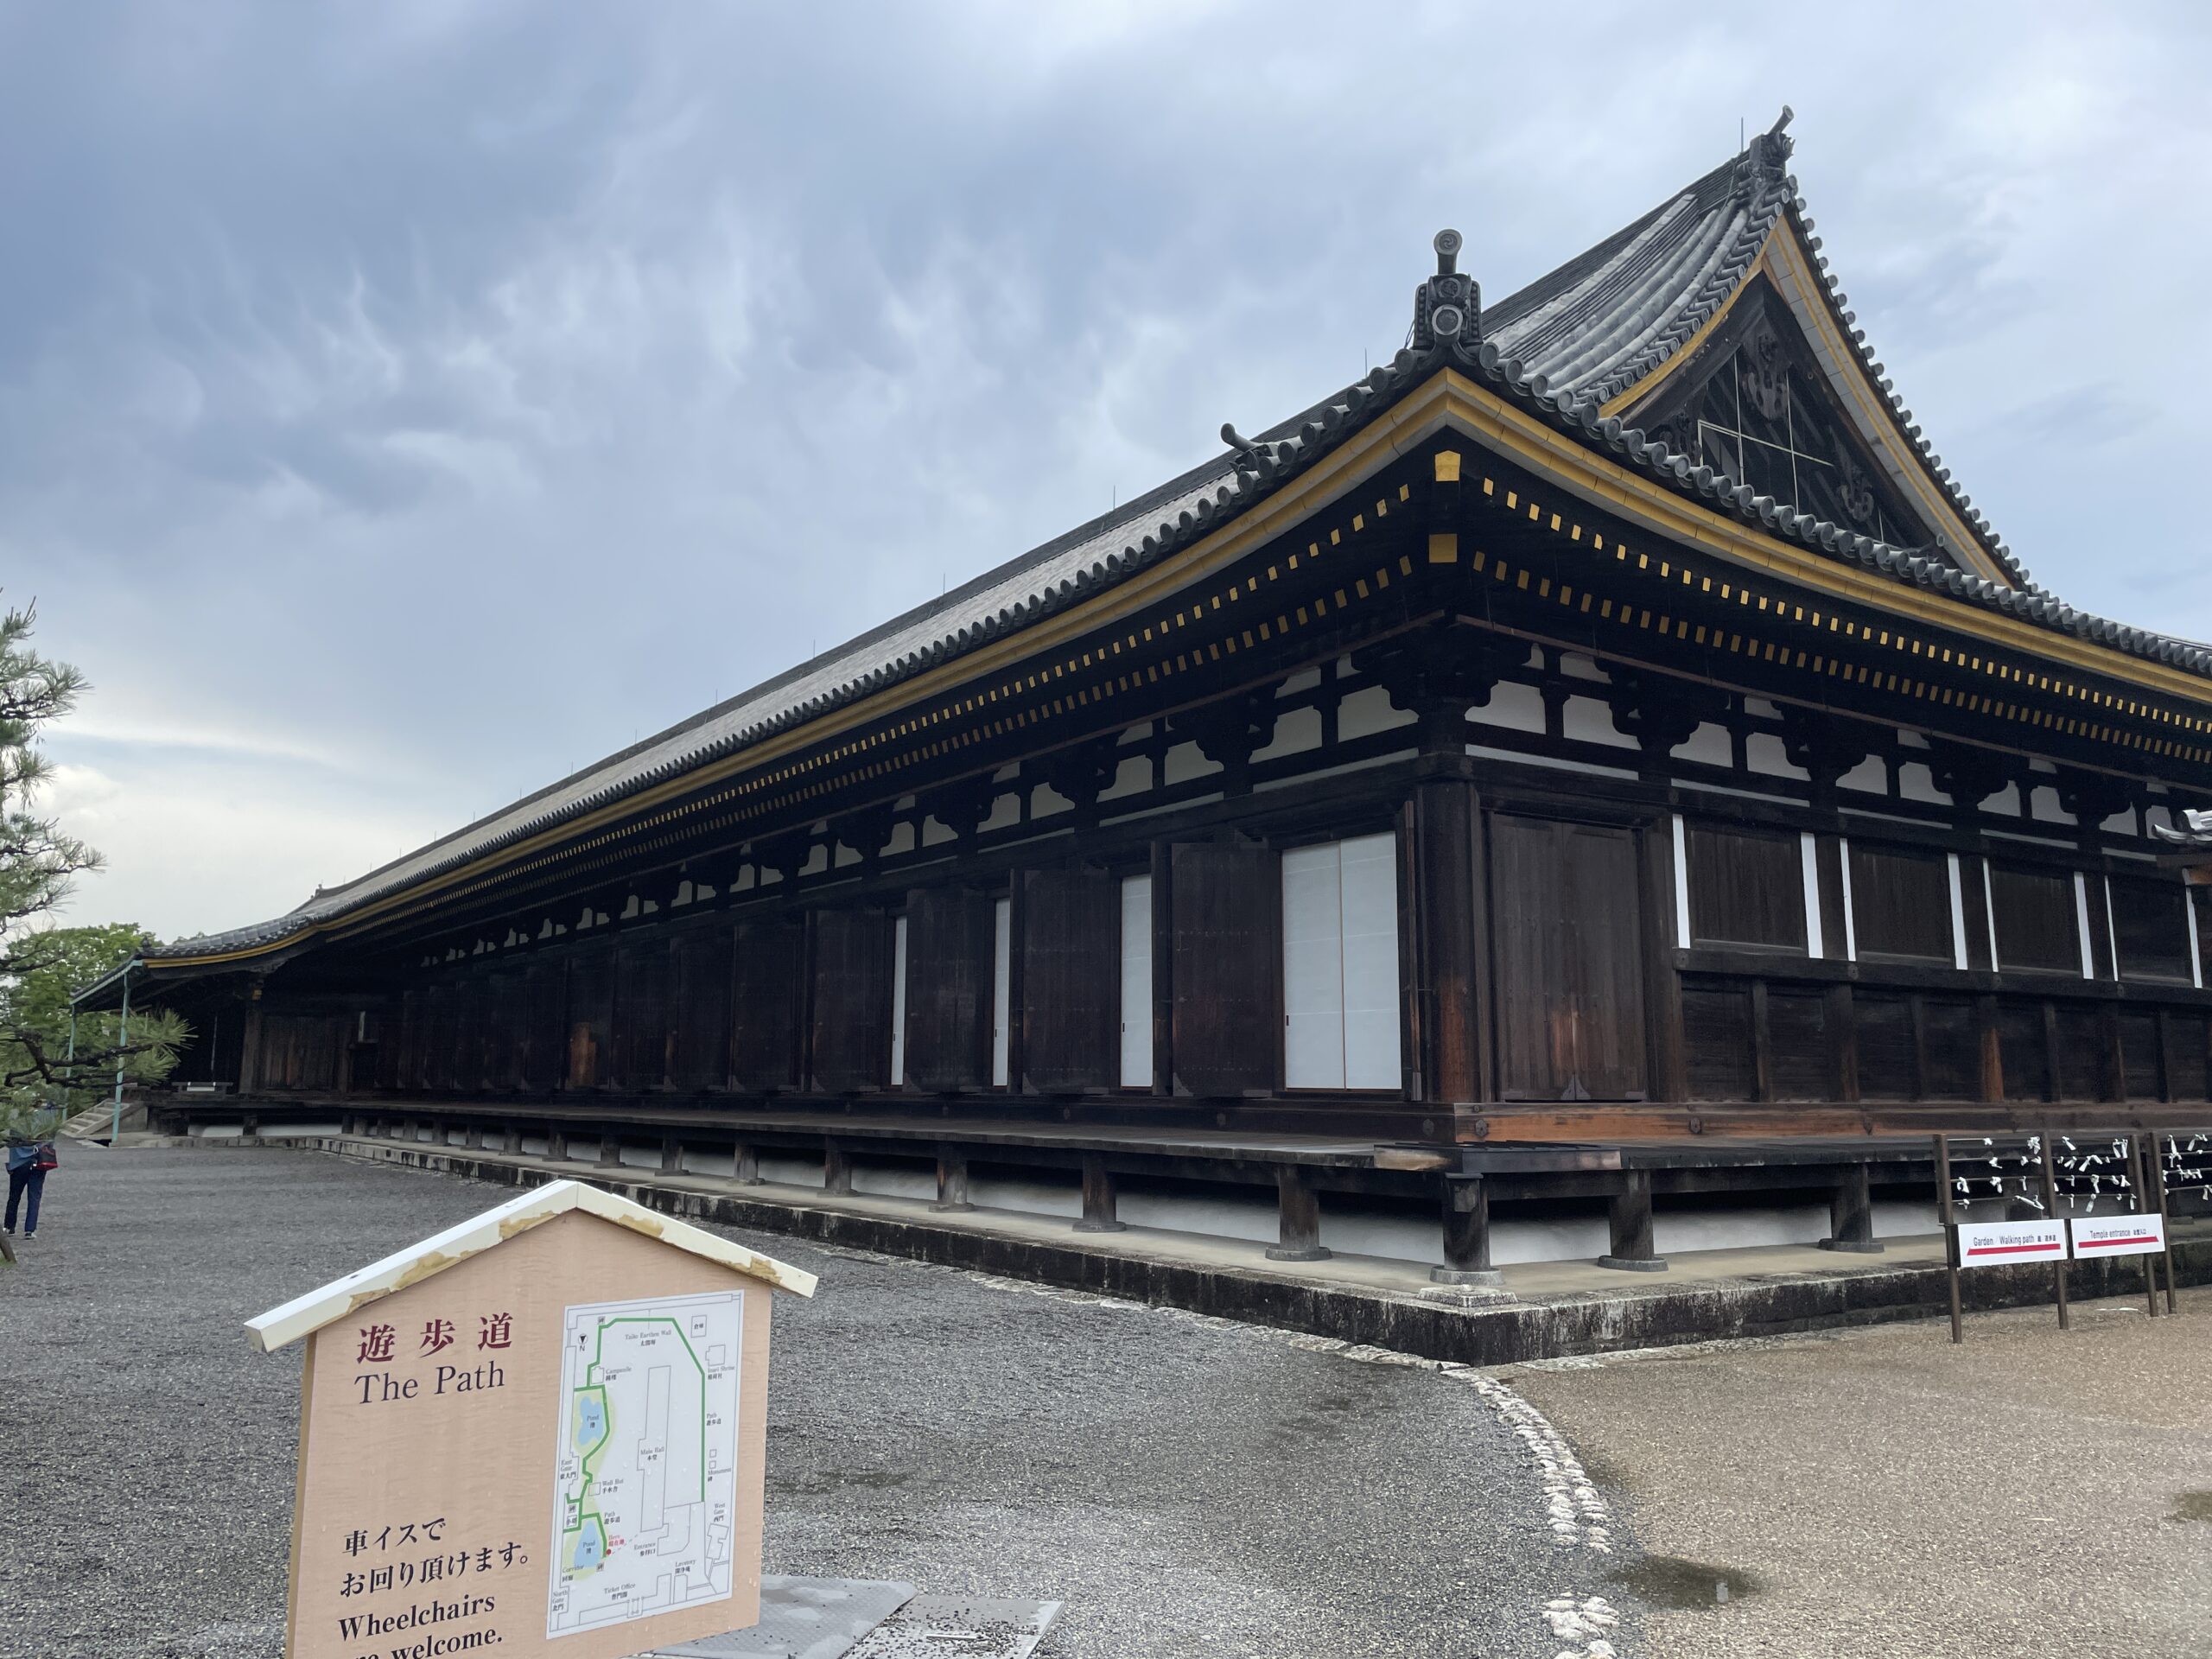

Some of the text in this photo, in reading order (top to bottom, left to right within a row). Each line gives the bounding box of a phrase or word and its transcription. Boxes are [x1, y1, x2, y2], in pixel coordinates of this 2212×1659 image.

[1973, 1236, 1993, 1246] Garden
[1999, 1236, 2021, 1245] Walking
[2022, 1235, 2035, 1246] path
[356, 1312, 513, 1363] 遊歩道
[354, 1360, 505, 1404] The Path
[341, 1517, 446, 1556] 車イスで
[340, 1541, 528, 1598] お回り頂けます。
[338, 1594, 495, 1642] Wheelchairs
[391, 1628, 502, 1659] welcome.
